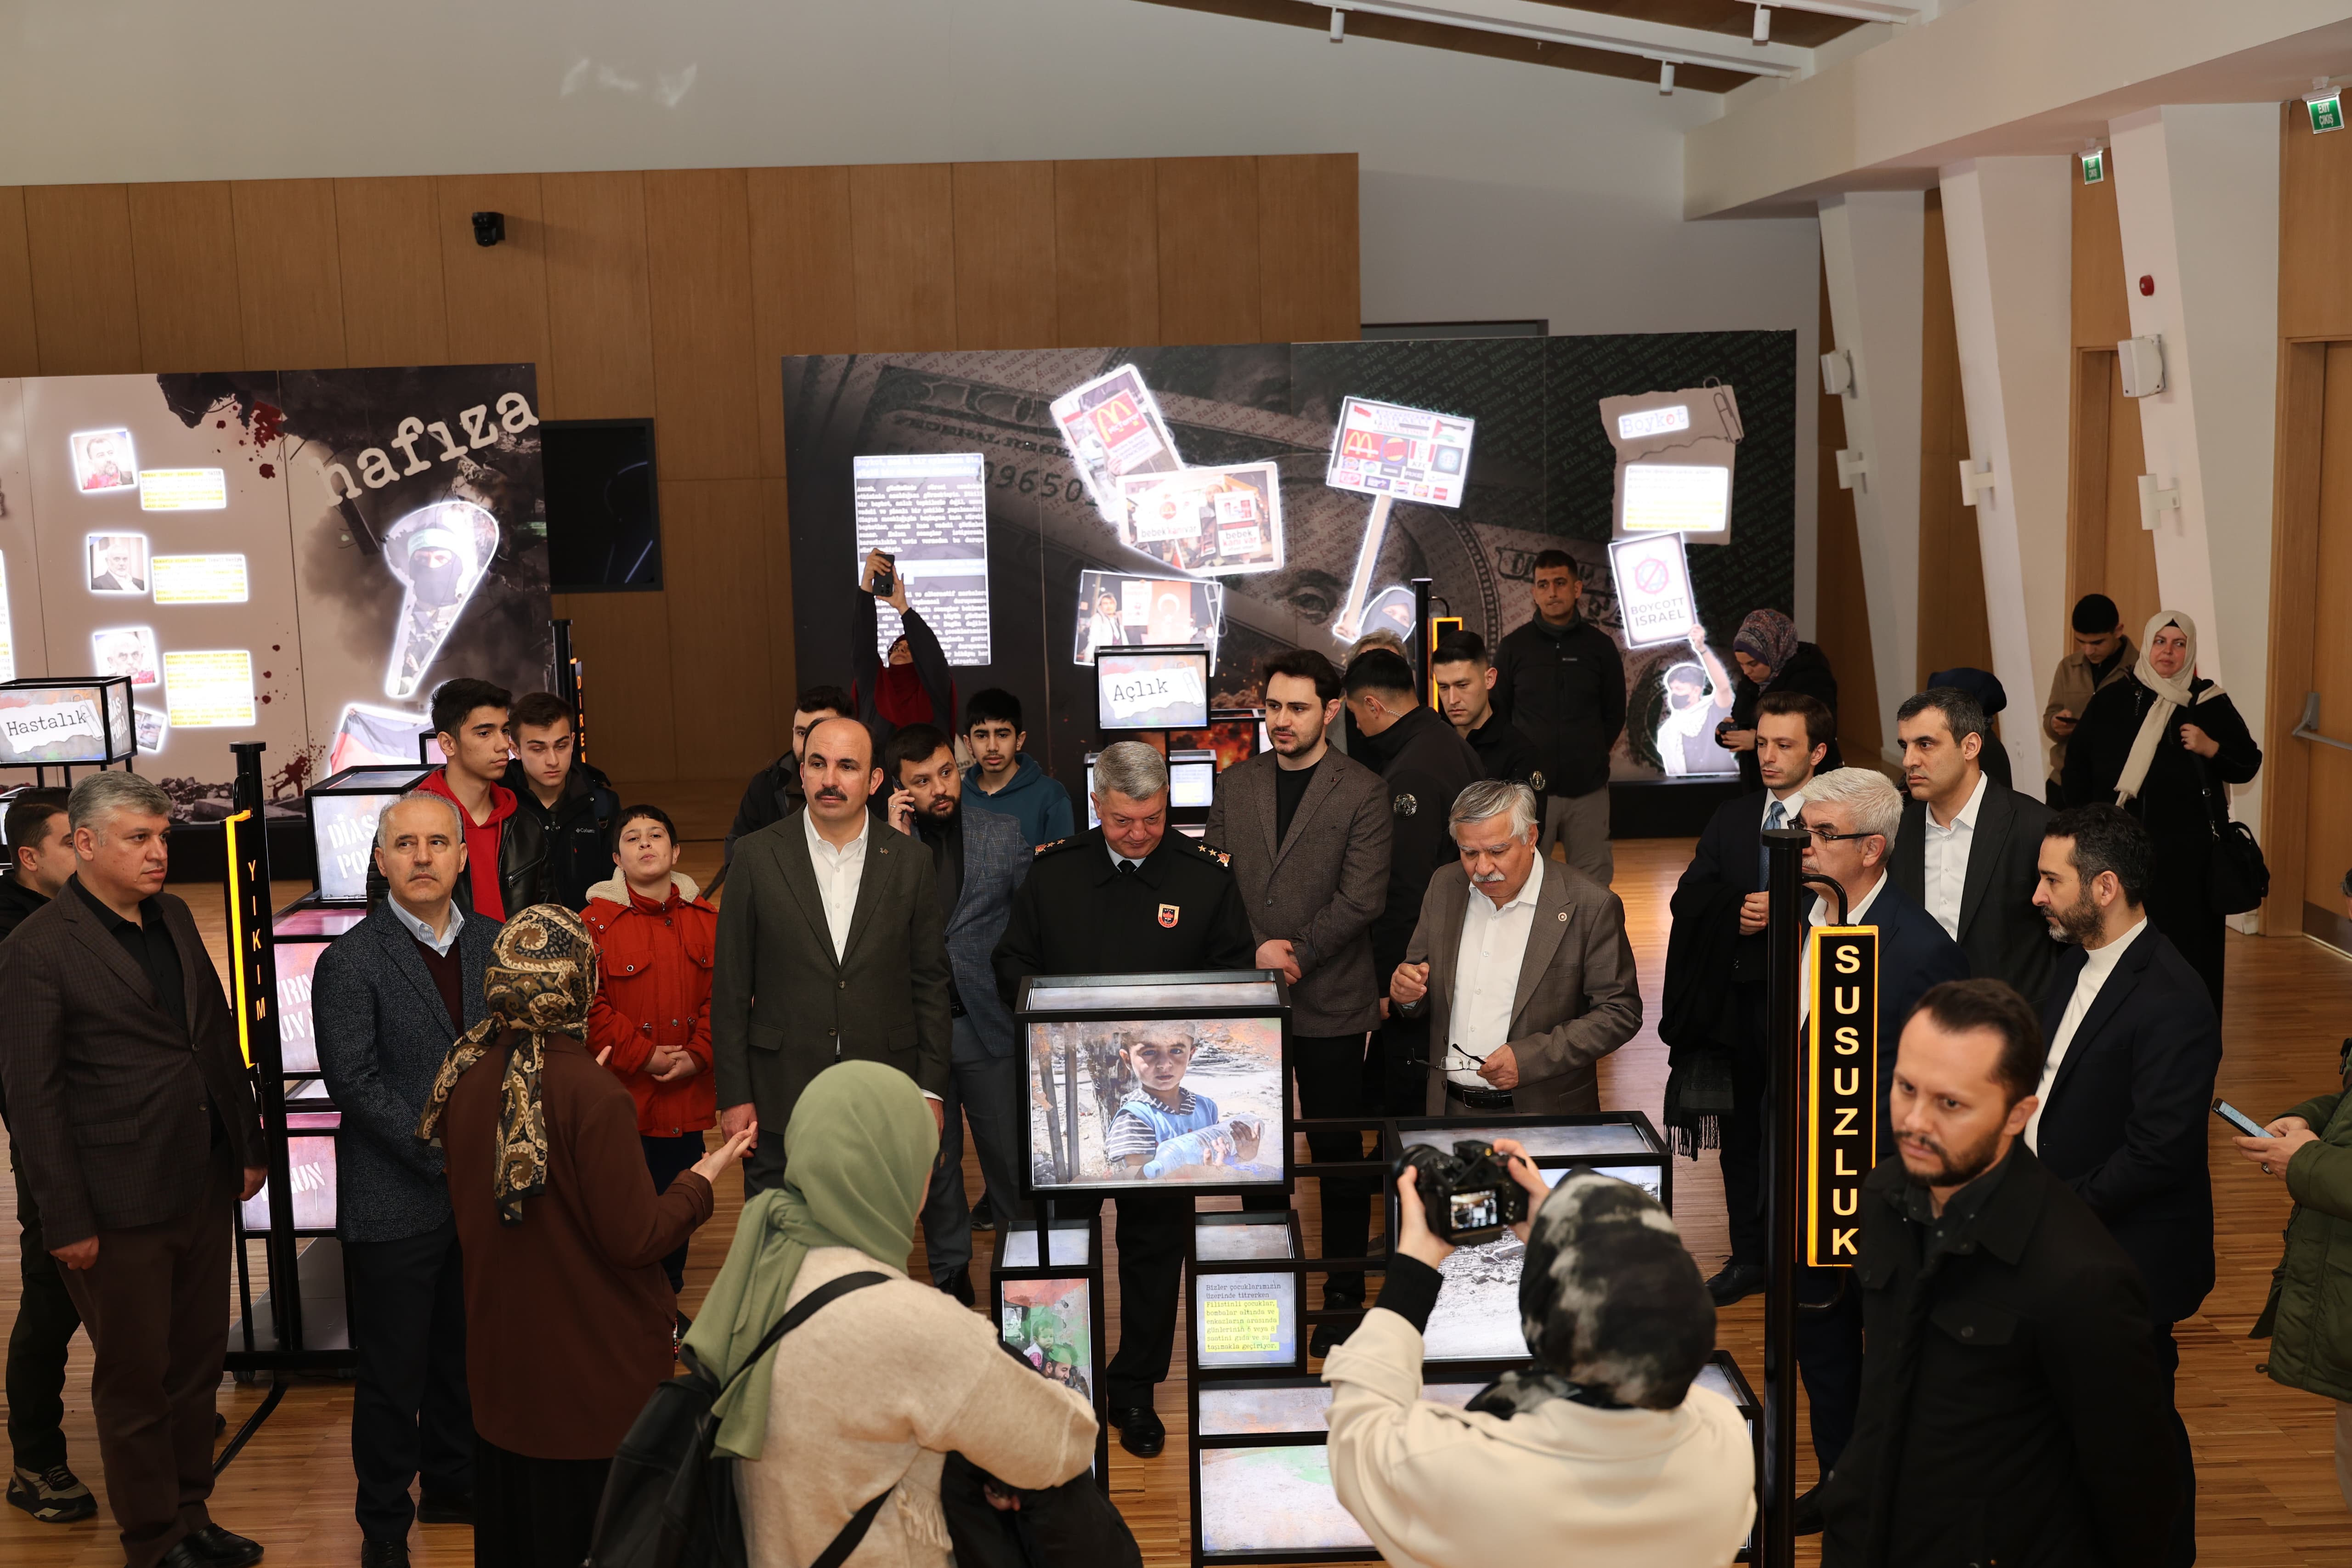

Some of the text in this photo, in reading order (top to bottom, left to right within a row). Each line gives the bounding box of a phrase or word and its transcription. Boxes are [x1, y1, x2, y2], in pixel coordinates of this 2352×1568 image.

[2317, 102, 2330, 114] EXIT
[1621, 408, 1687, 435] Boykot
[312, 392, 539, 506] hafıza
[1630, 597, 1685, 615] BOYCOTT
[1635, 609, 1686, 628] ISRAEL
[1113, 678, 1169, 702] Açlık
[6, 710, 87, 736] Hastalık
[248, 859, 266, 1021] YIKIM
[1832, 945, 1861, 1256] SUSUZLUK
[1230, 1283, 1281, 1291] çocuklarımızın
[1244, 1300, 1275, 1308] çocuklar,
[1207, 1325, 1244, 1334] günlerinin
[1207, 1342, 1277, 1351] taşımakla geçiriyor.
